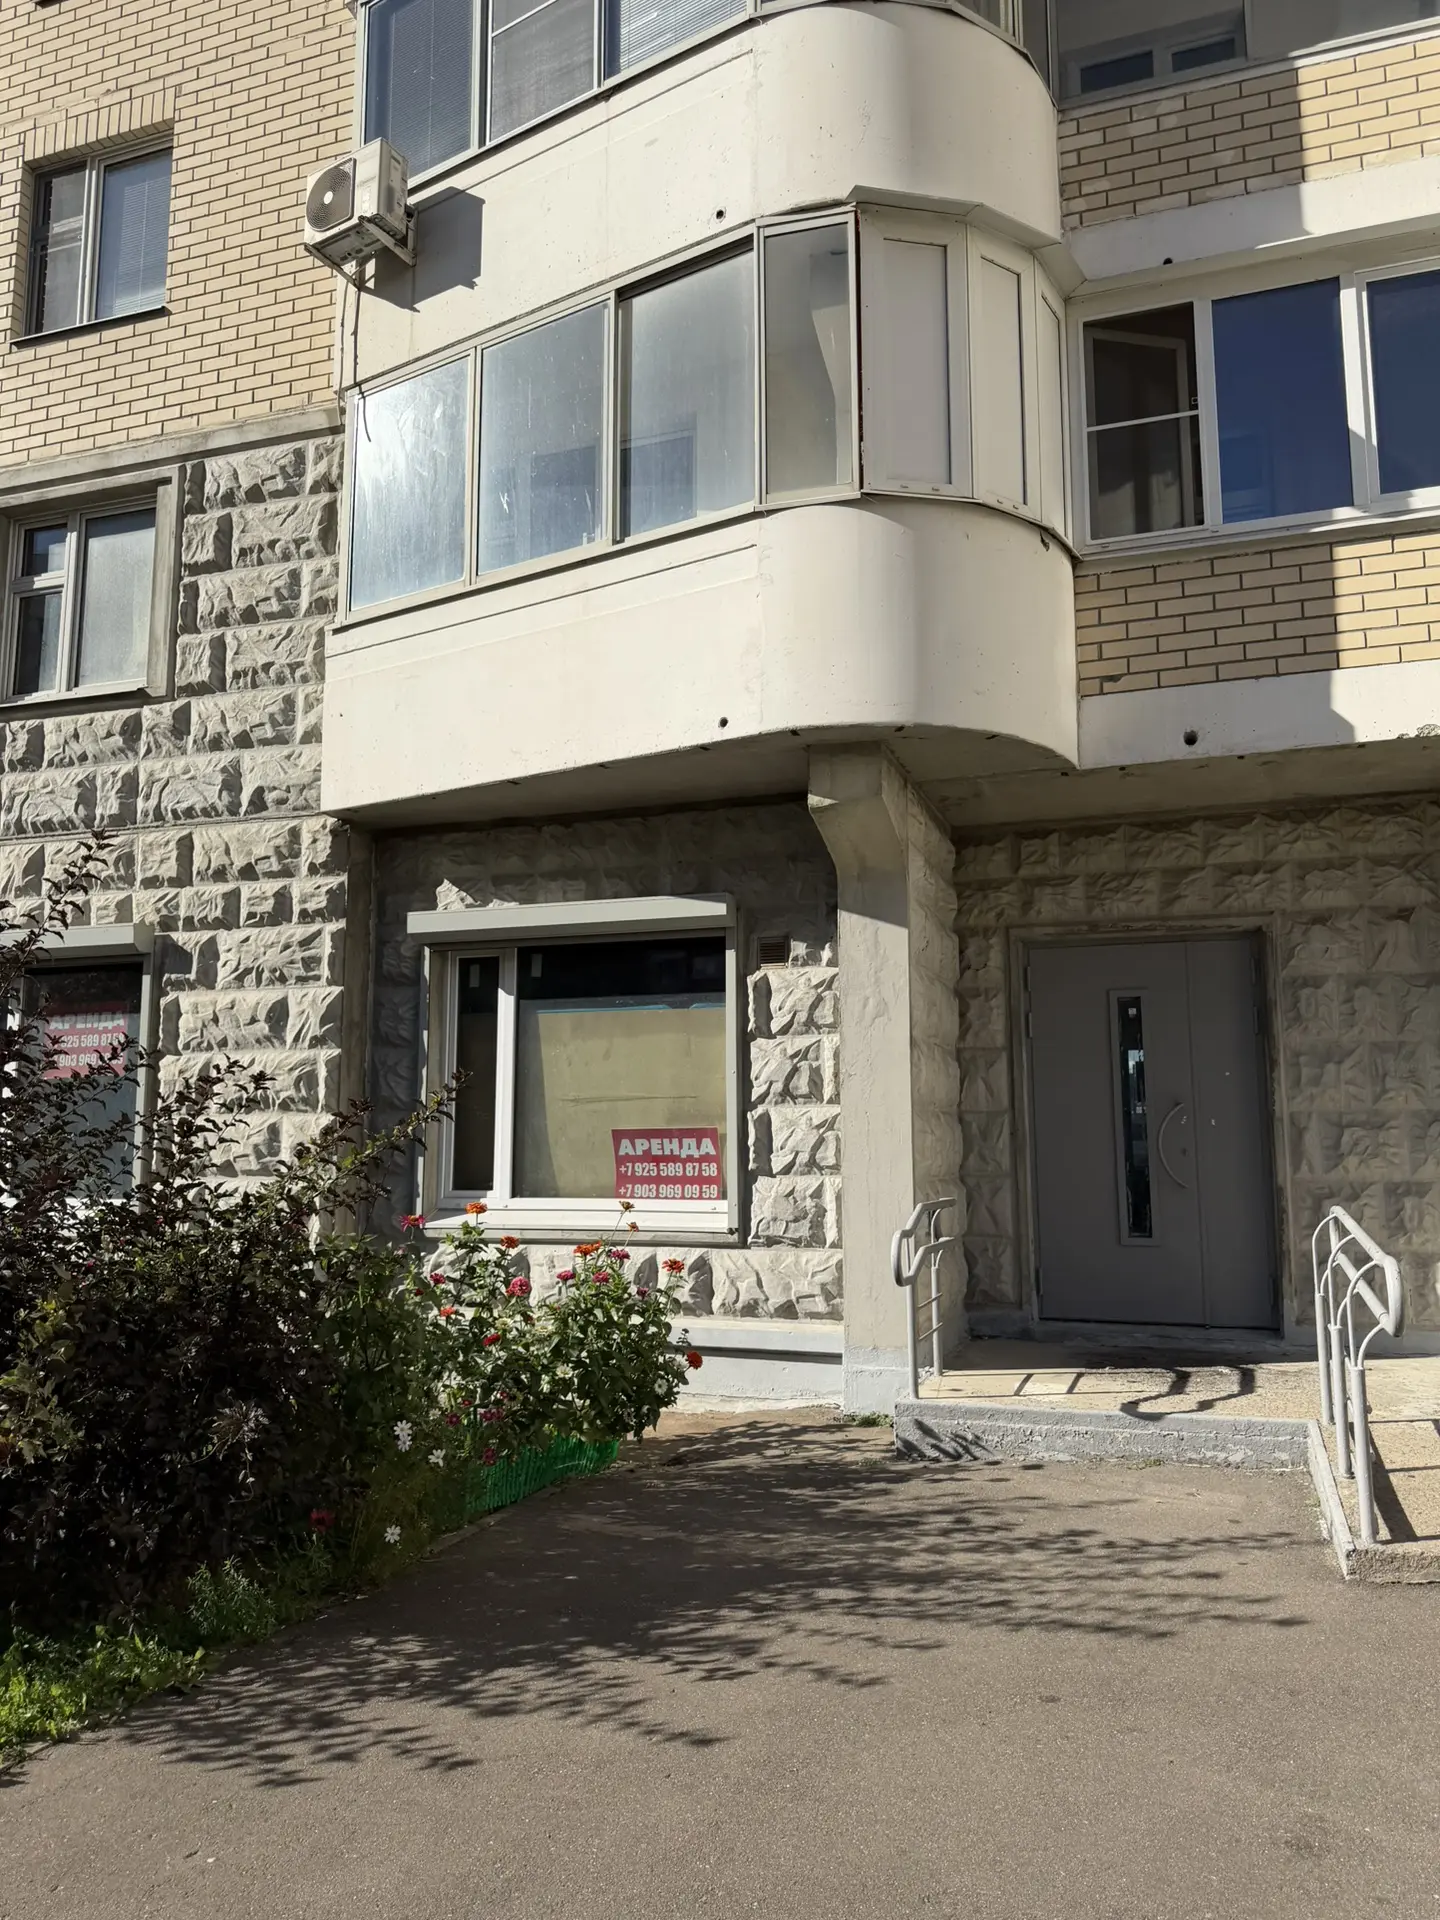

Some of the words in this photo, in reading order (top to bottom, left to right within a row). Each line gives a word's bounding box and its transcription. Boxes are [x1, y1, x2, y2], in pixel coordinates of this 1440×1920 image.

[49, 1012, 125, 1030] АРЕНДА
[80, 1034, 99, 1047] 589
[59, 1054, 77, 1066] 903
[618, 1138, 716, 1158] АРЕНДА
[619, 1162, 632, 1176] +7
[634, 1162, 657, 1176] 925
[659, 1162, 683, 1176] 589
[686, 1162, 699, 1176] 87
[702, 1162, 717, 1176] 58
[619, 1184, 632, 1198] +7
[634, 1184, 656, 1198] 903
[659, 1184, 682, 1198] 969
[684, 1184, 699, 1198] 09
[702, 1184, 718, 1198] 59
